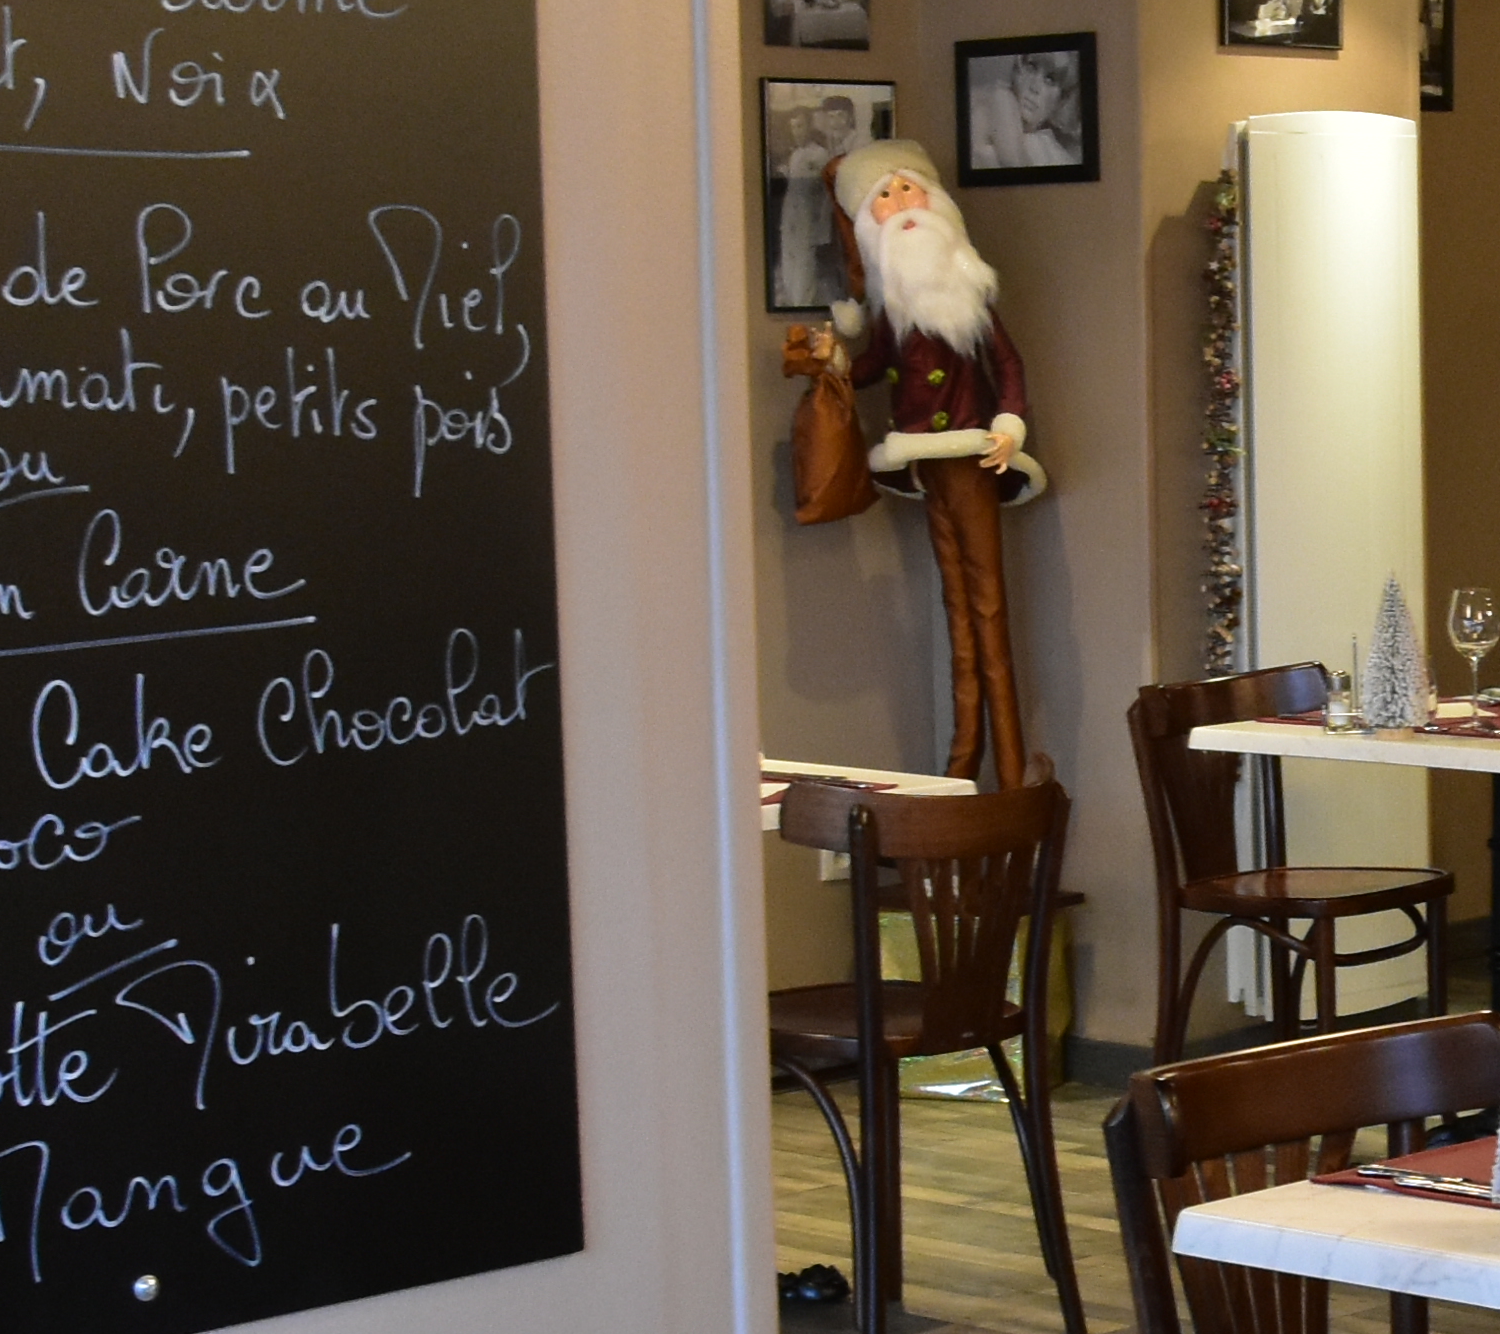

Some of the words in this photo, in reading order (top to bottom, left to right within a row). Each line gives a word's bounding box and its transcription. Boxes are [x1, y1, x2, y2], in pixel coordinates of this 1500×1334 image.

[111, 29, 285, 122] Noix
[0, 210, 100, 307] de
[136, 203, 271, 319] Porc
[300, 280, 371, 324] au
[220, 345, 379, 475] petits
[412, 370, 514, 499] pois
[77, 507, 309, 621] Carne
[31, 672, 224, 793] Cake
[255, 627, 560, 766] Chocolat
[37, 902, 145, 968] ou
[113, 913, 562, 1111] Mirabelle
